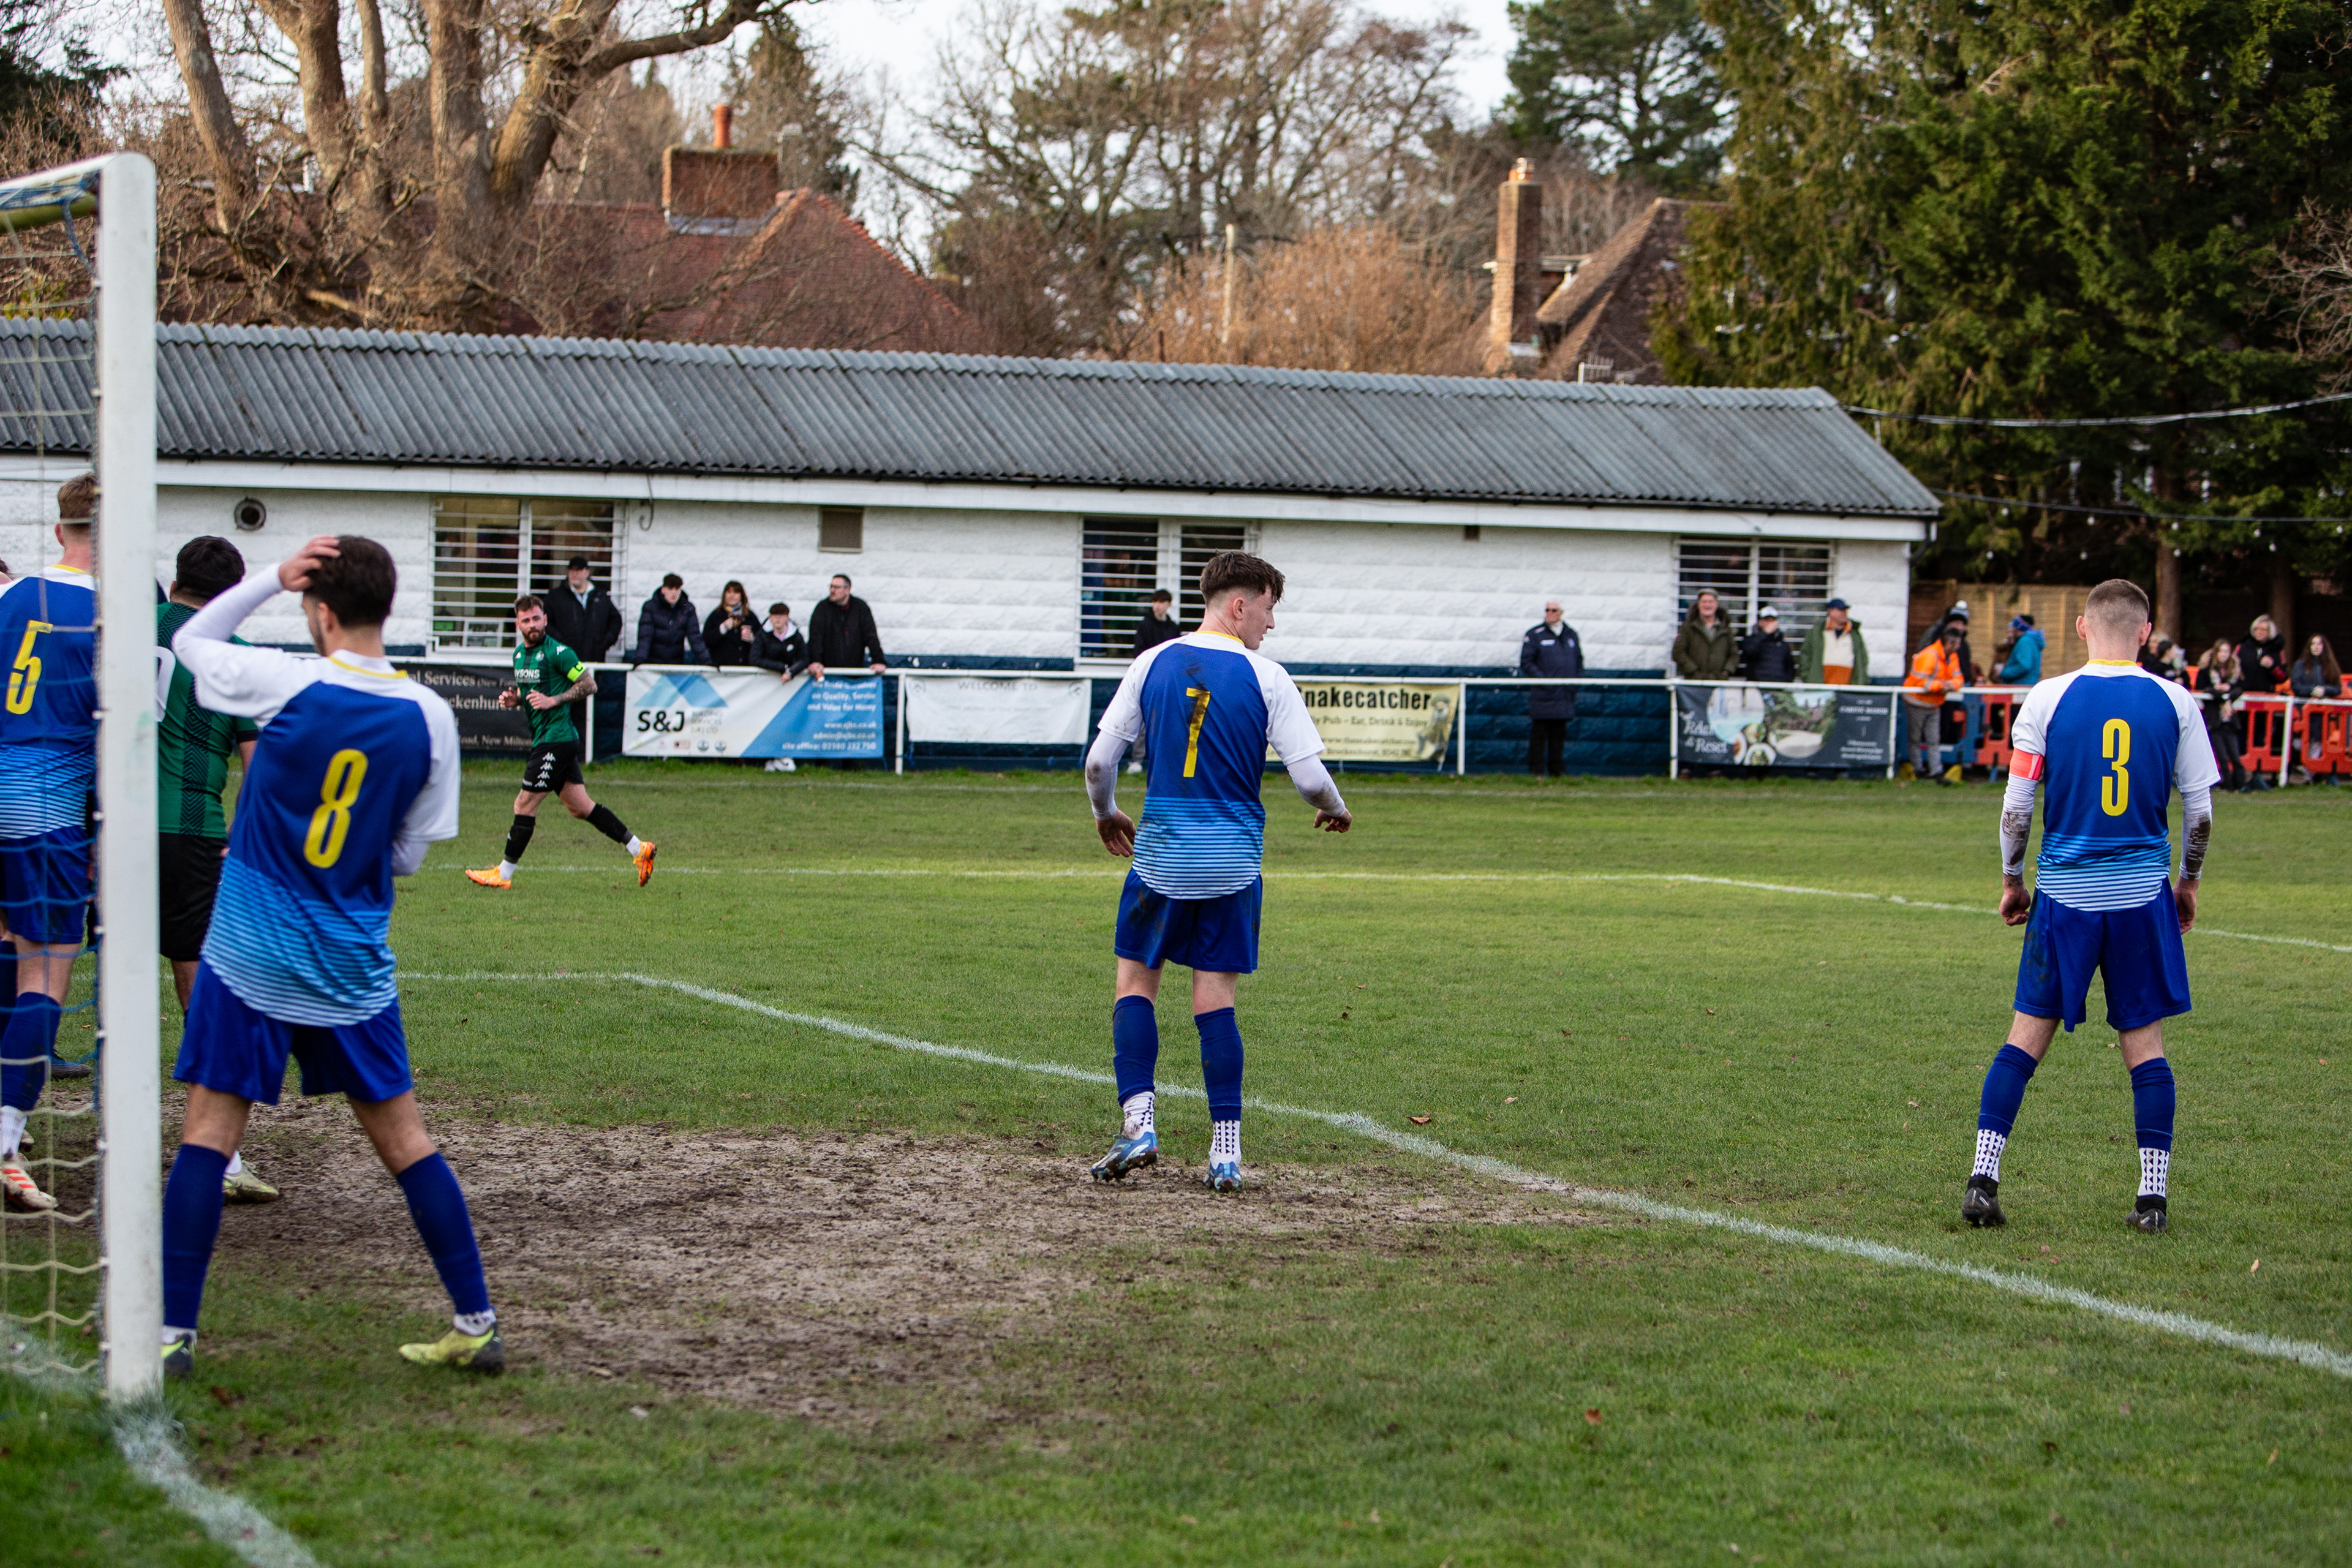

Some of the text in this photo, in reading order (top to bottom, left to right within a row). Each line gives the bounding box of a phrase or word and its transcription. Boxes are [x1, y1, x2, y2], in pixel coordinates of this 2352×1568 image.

[6, 620, 53, 714] 5
[424, 670, 476, 687] Services
[957, 680, 1038, 692] WELCOME TO
[637, 710, 685, 732] S&J
[1297, 687, 1431, 710] nakecatcher
[1183, 687, 1211, 778] 7
[2101, 718, 2131, 816] 3
[304, 749, 368, 869] 8
